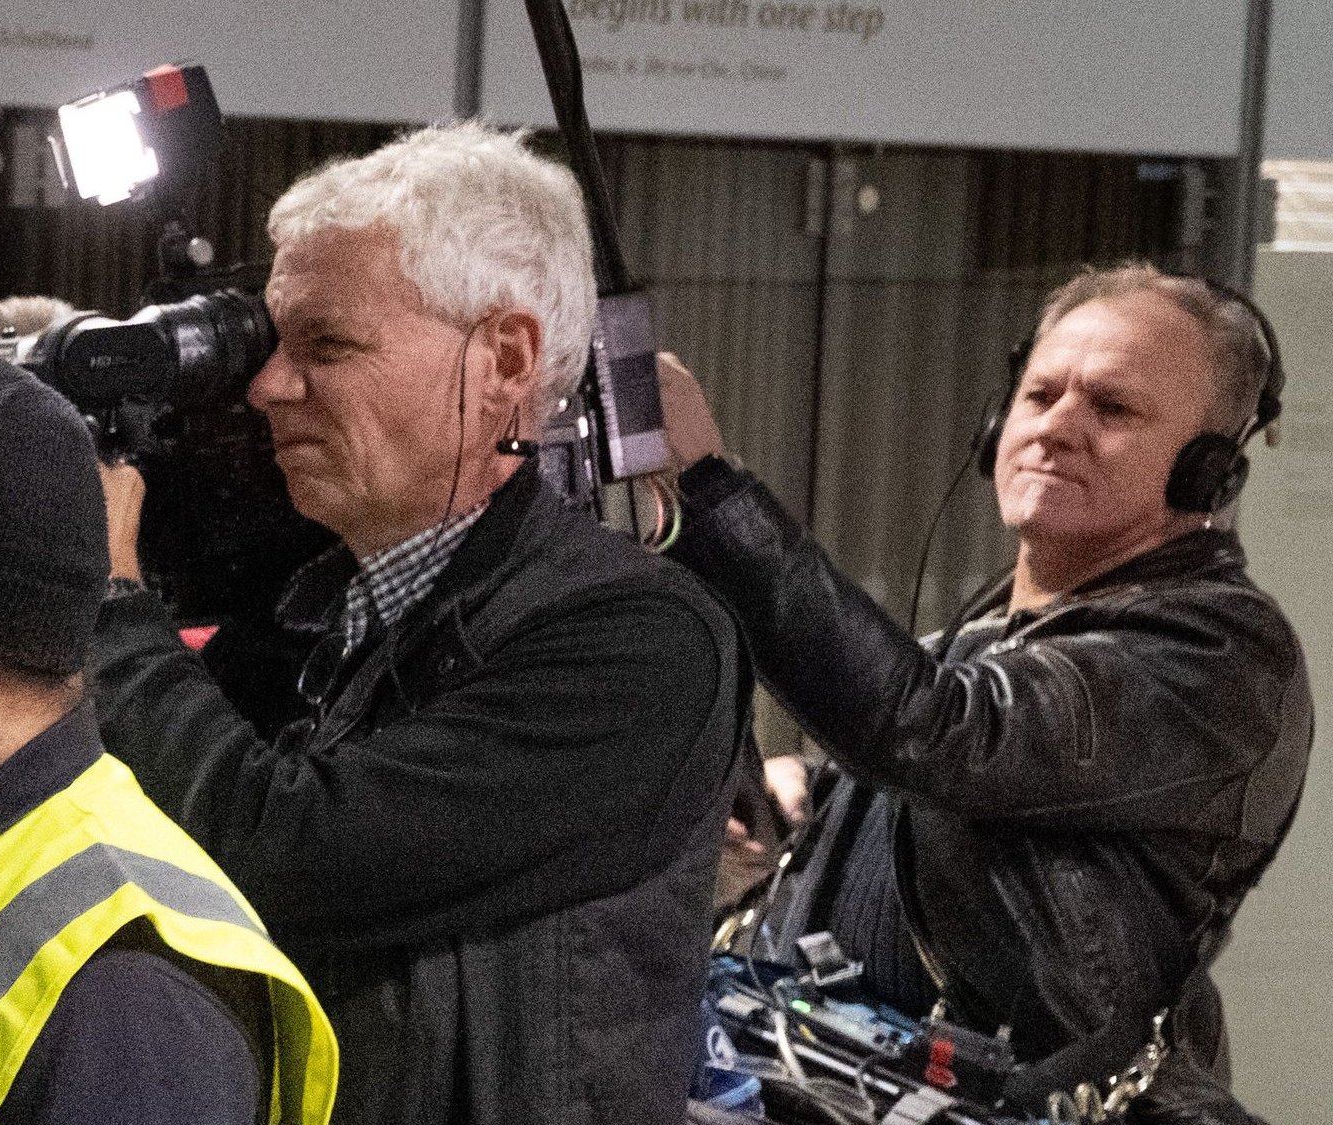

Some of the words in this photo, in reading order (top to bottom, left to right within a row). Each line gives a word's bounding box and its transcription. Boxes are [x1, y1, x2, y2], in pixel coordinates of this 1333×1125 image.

[682, 0, 750, 27] with
[758, 3, 815, 31] one
[824, 3, 885, 45] step
